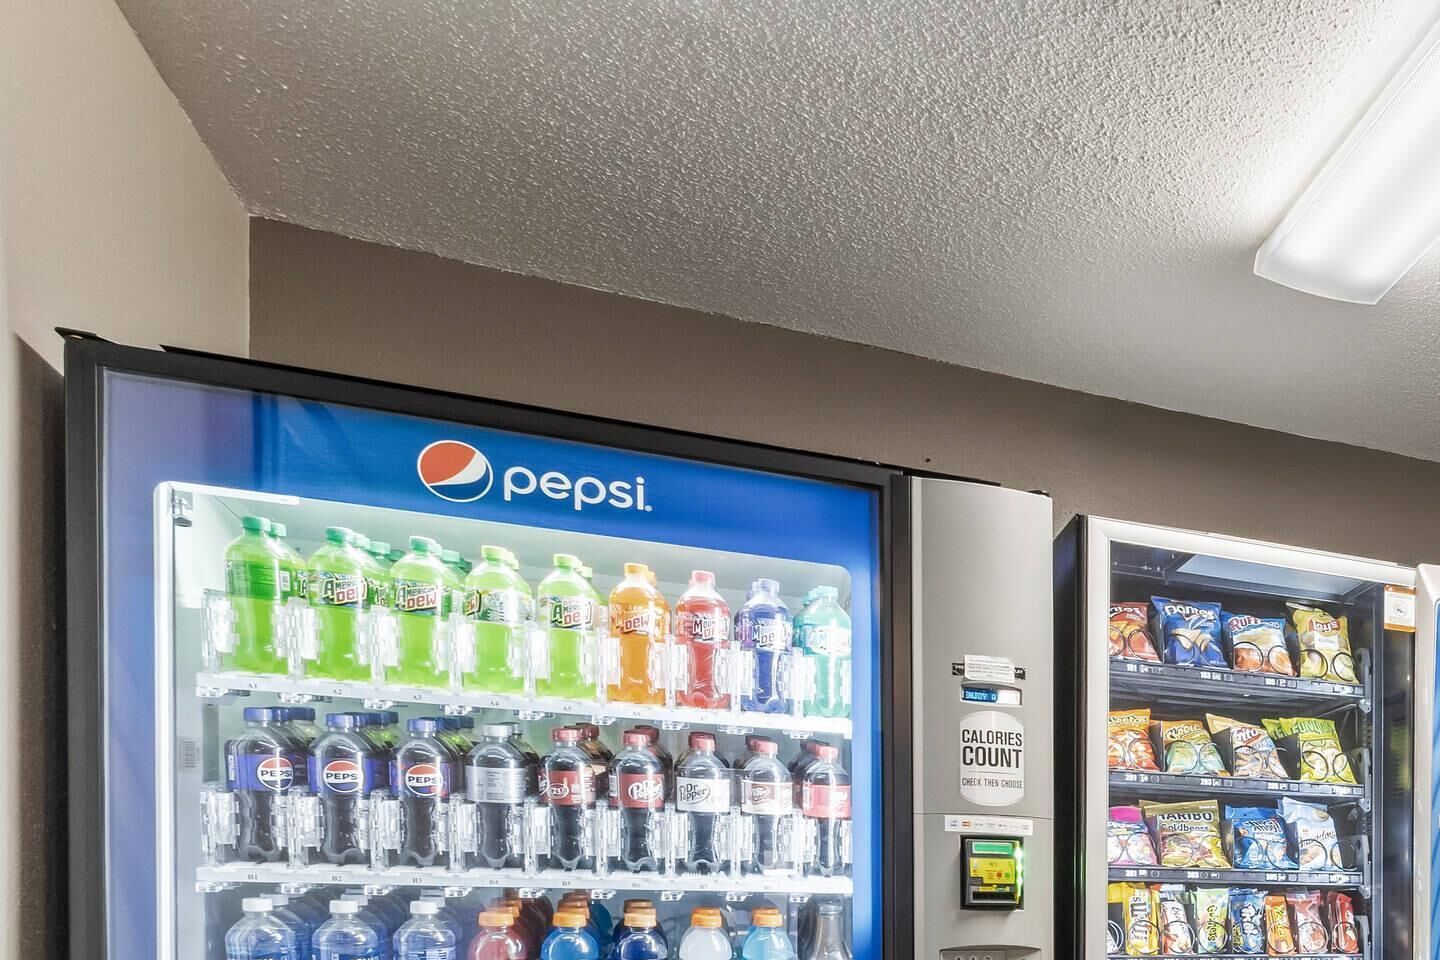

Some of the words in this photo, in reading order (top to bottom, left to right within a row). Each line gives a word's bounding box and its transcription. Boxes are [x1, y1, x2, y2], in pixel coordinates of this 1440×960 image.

[962, 728, 1023, 747] CALORIES
[962, 746, 1023, 769] COUNT
[325, 771, 361, 781] PEPS
[408, 775, 440, 785] PEPS
[686, 783, 699, 792] Dr
[961, 777, 982, 787] CHECK
[984, 778, 999, 788] THEN
[1000, 779, 1023, 790] CHOOSE
[678, 786, 709, 802] Pepper
